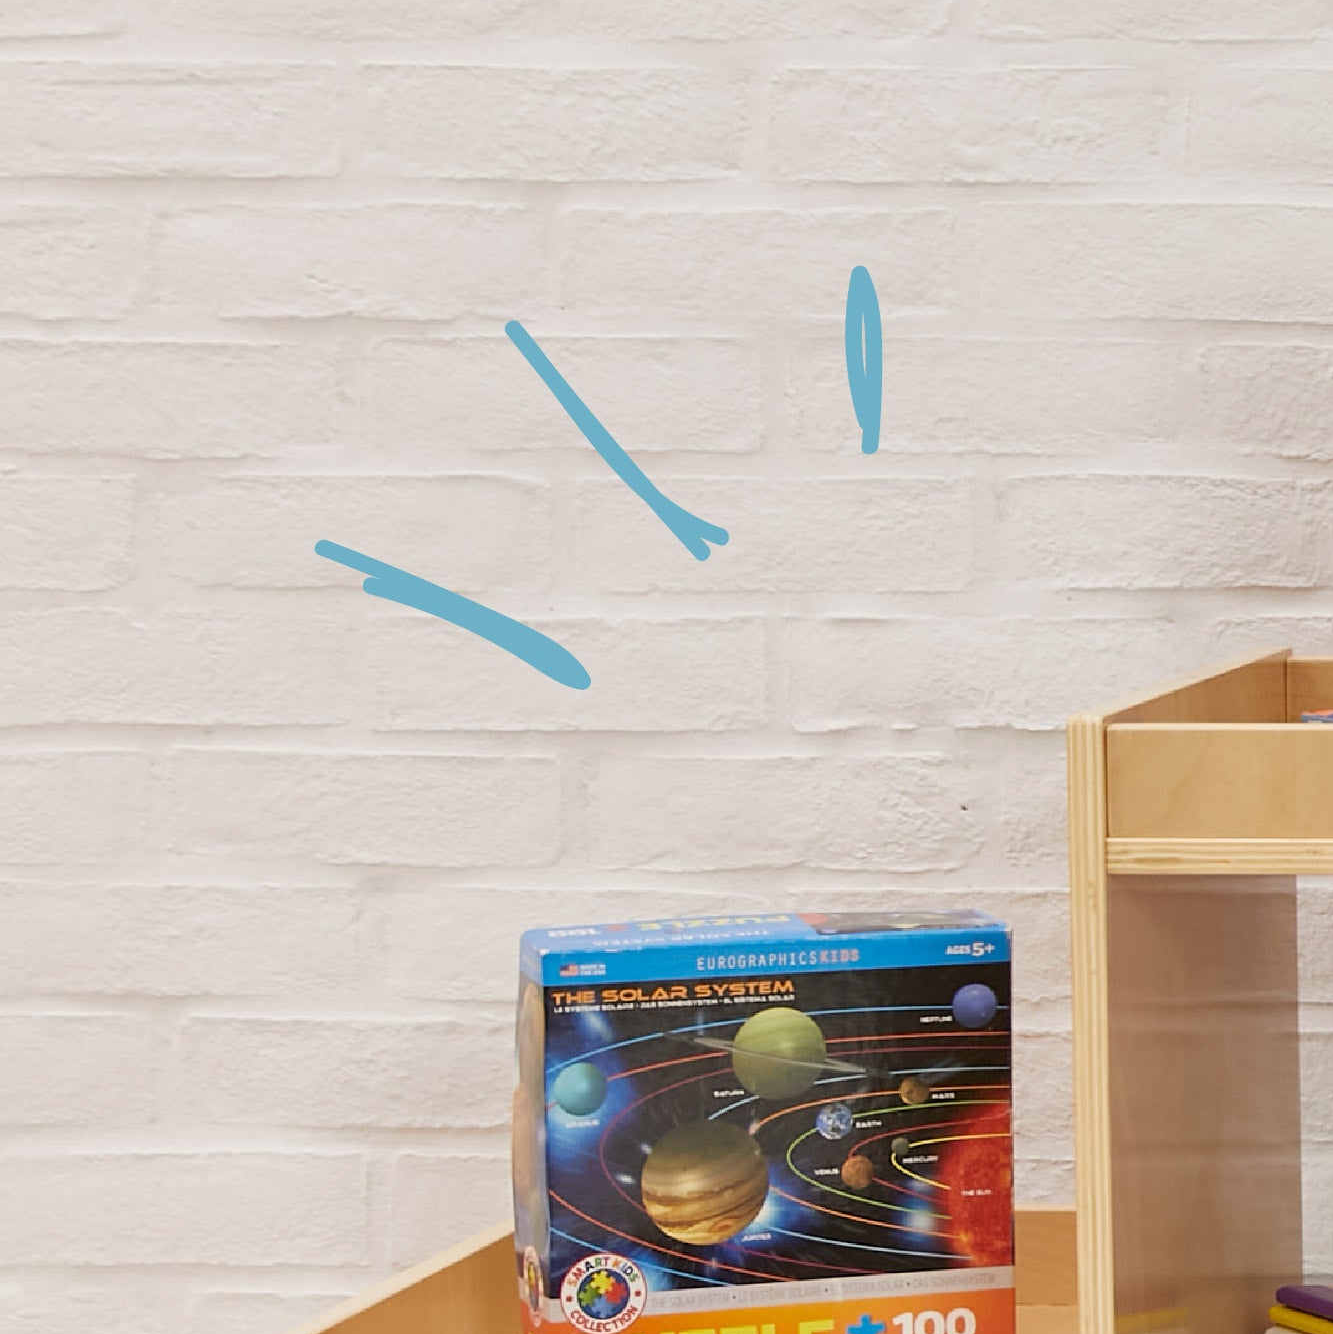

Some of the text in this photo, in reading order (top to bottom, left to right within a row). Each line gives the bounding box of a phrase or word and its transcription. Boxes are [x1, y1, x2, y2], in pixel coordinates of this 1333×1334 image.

[945, 941, 995, 957] AGES 5+
[552, 979, 795, 1006] THE SOLAR SYSTEM
[567, 1258, 640, 1287] SMART KIDS
[570, 1305, 639, 1333] COLLECTION
